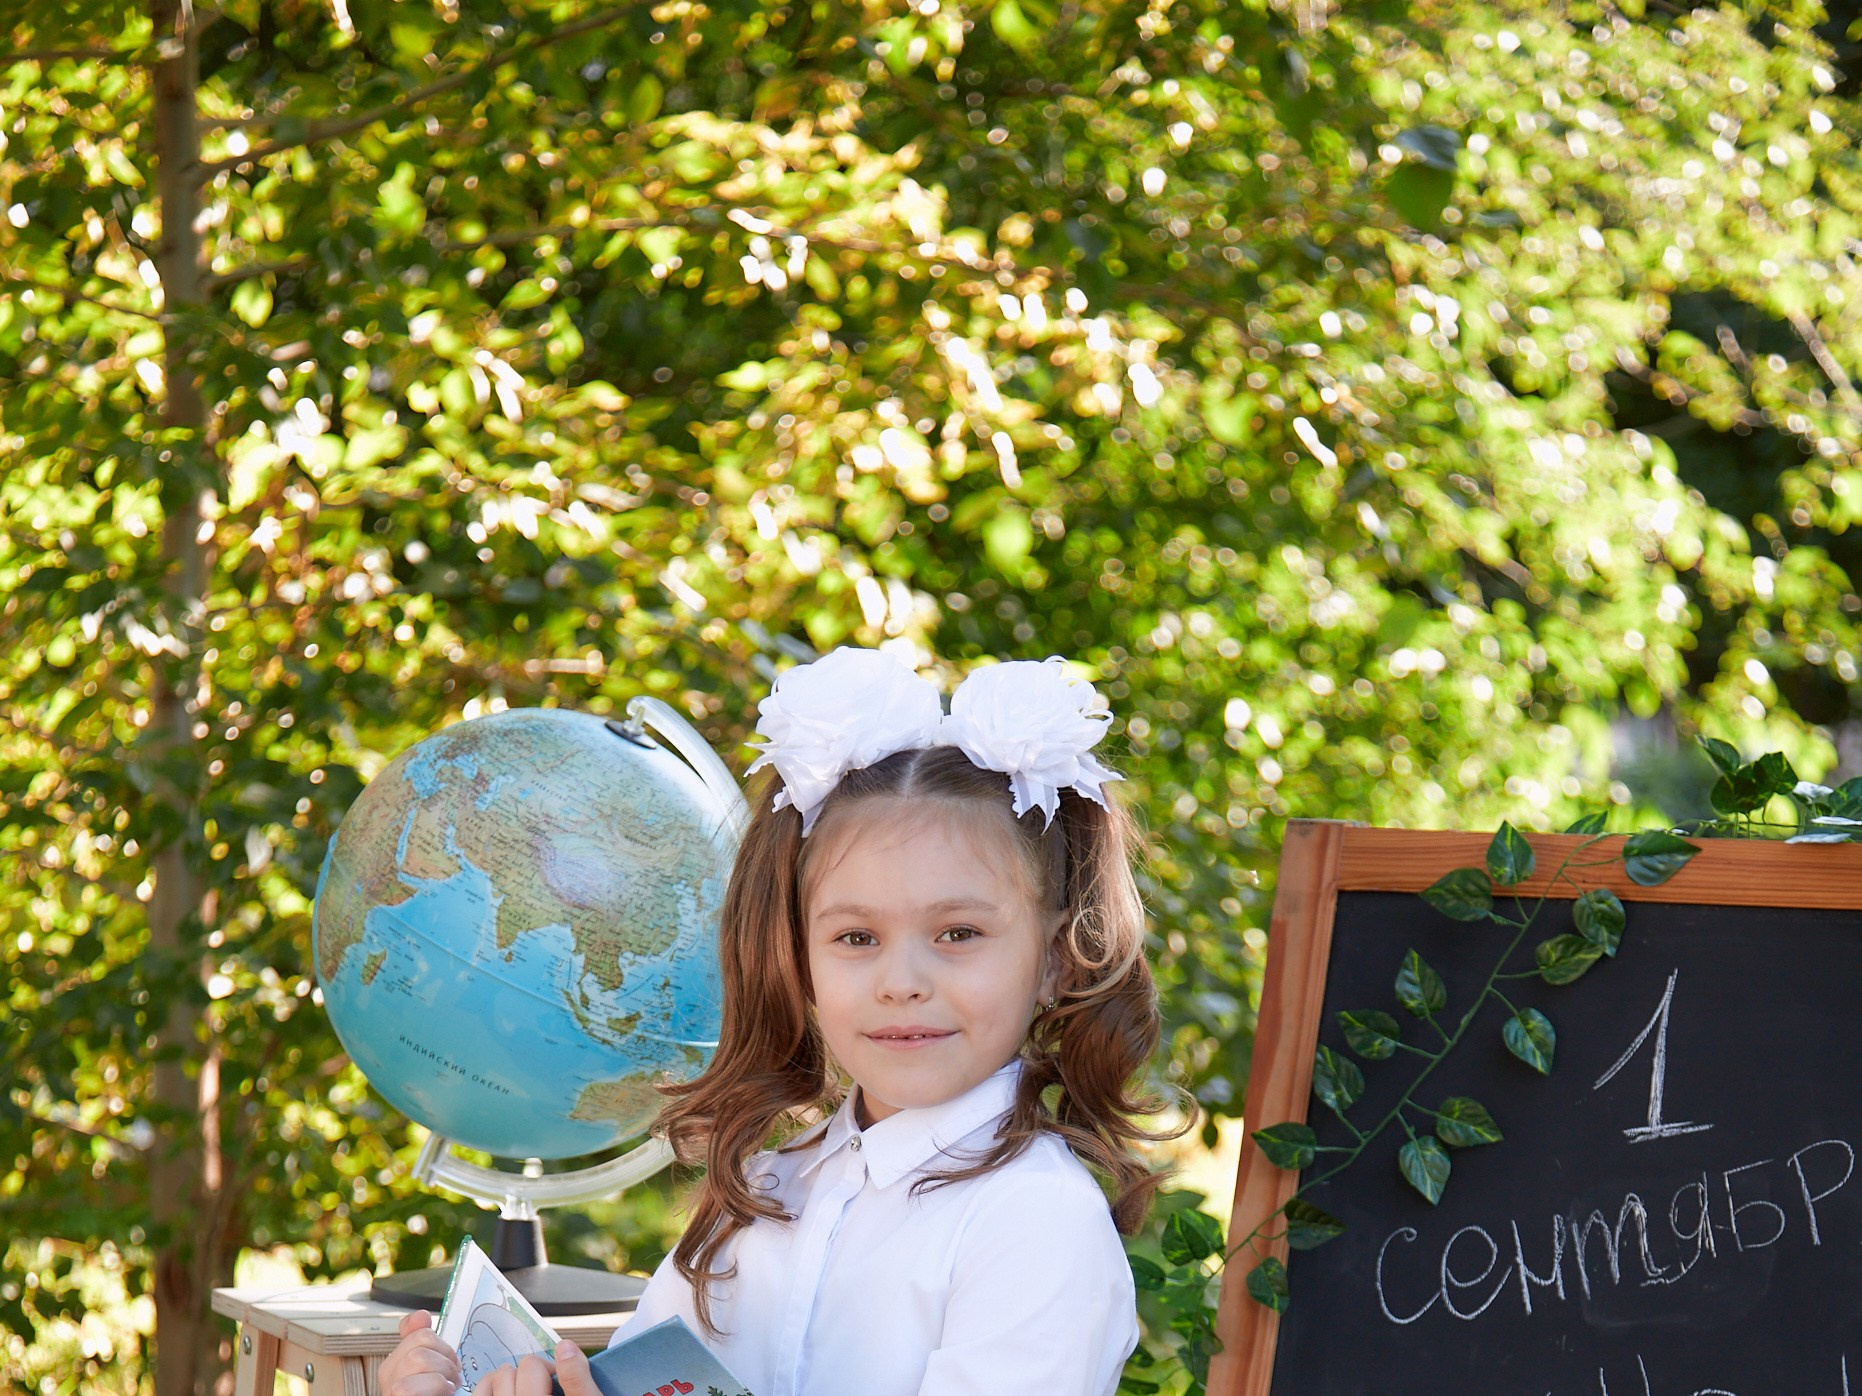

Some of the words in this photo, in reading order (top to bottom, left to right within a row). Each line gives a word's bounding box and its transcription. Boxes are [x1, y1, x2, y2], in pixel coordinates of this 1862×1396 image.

[399, 1034, 467, 1076] ИНДИЙСКИЙ
[471, 1074, 510, 1096] ОКЕАН
[1593, 967, 1714, 1142] 1
